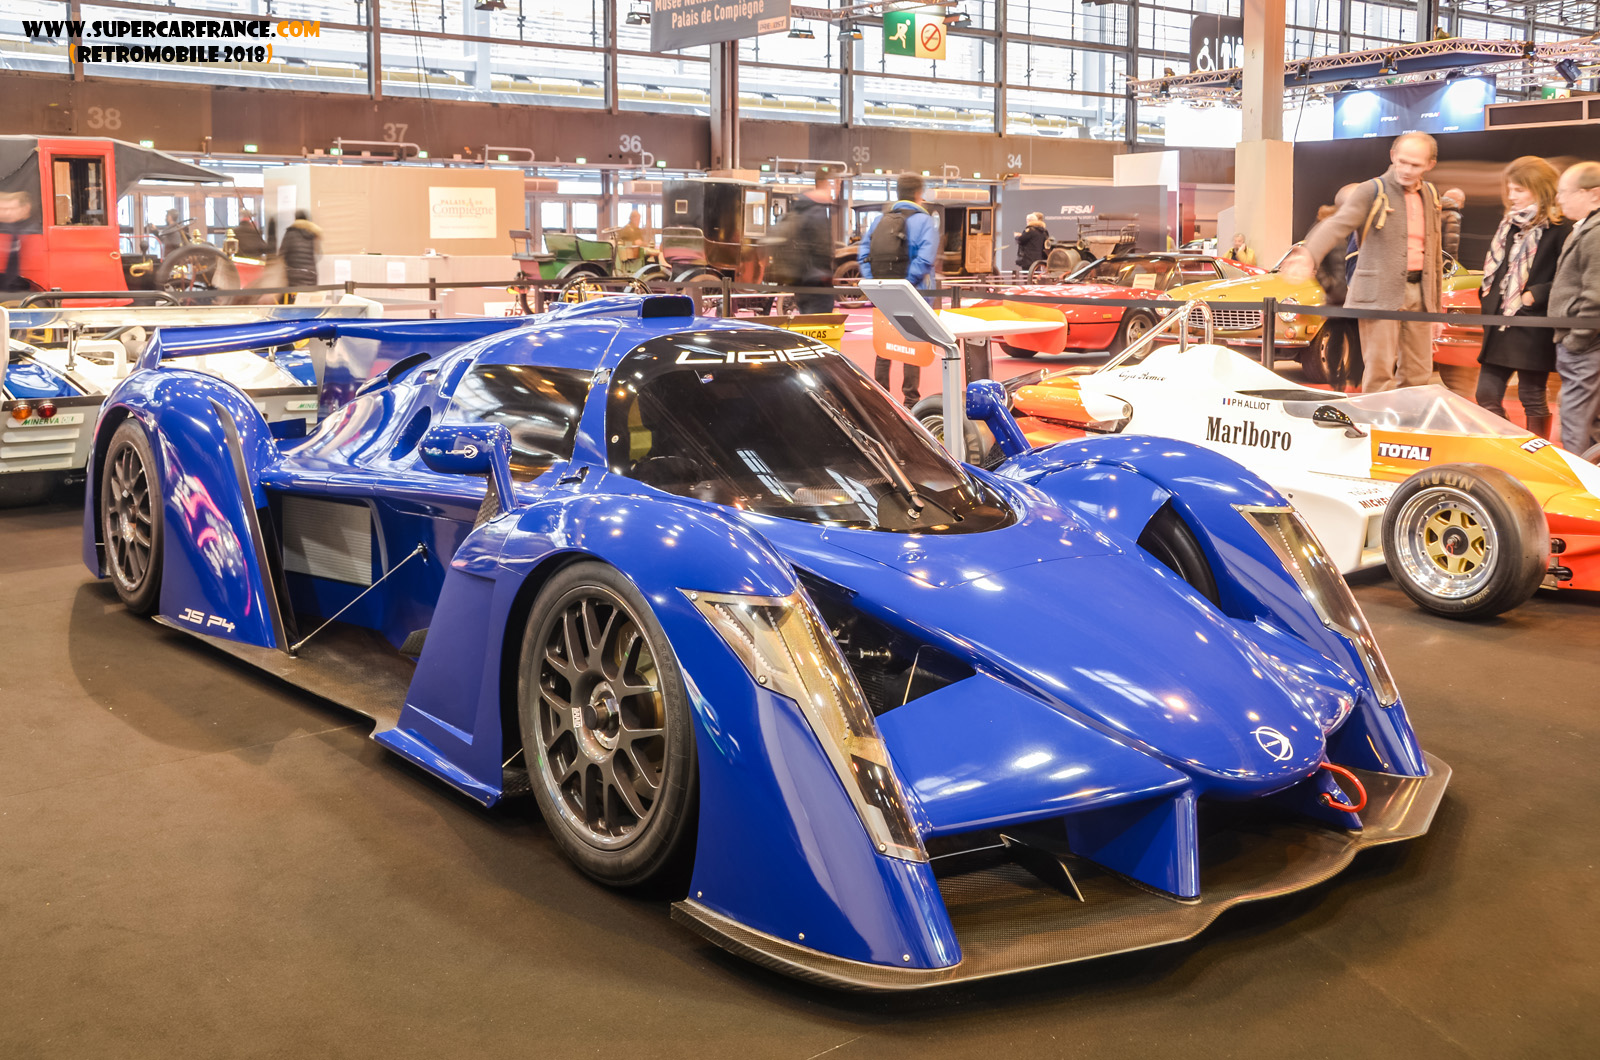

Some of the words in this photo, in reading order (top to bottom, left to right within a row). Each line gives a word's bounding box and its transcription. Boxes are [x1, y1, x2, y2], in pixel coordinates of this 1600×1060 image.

[671, 9, 699, 29] Palais
[701, 6, 712, 24] de
[714, 0, 765, 22] Compiègne
[87, 106, 122, 130] 38
[383, 122, 409, 143] 37
[619, 134, 642, 153] 36
[852, 146, 871, 163] 35
[1007, 153, 1023, 169] 34
[1060, 205, 1095, 214] FFSA
[675, 344, 840, 364] LIGIER
[1206, 415, 1292, 451] Marlboro
[1379, 442, 1431, 461] TOTAL
[1358, 496, 1392, 509] MICHEL
[178, 607, 205, 625] JS
[206, 614, 236, 633] P4
